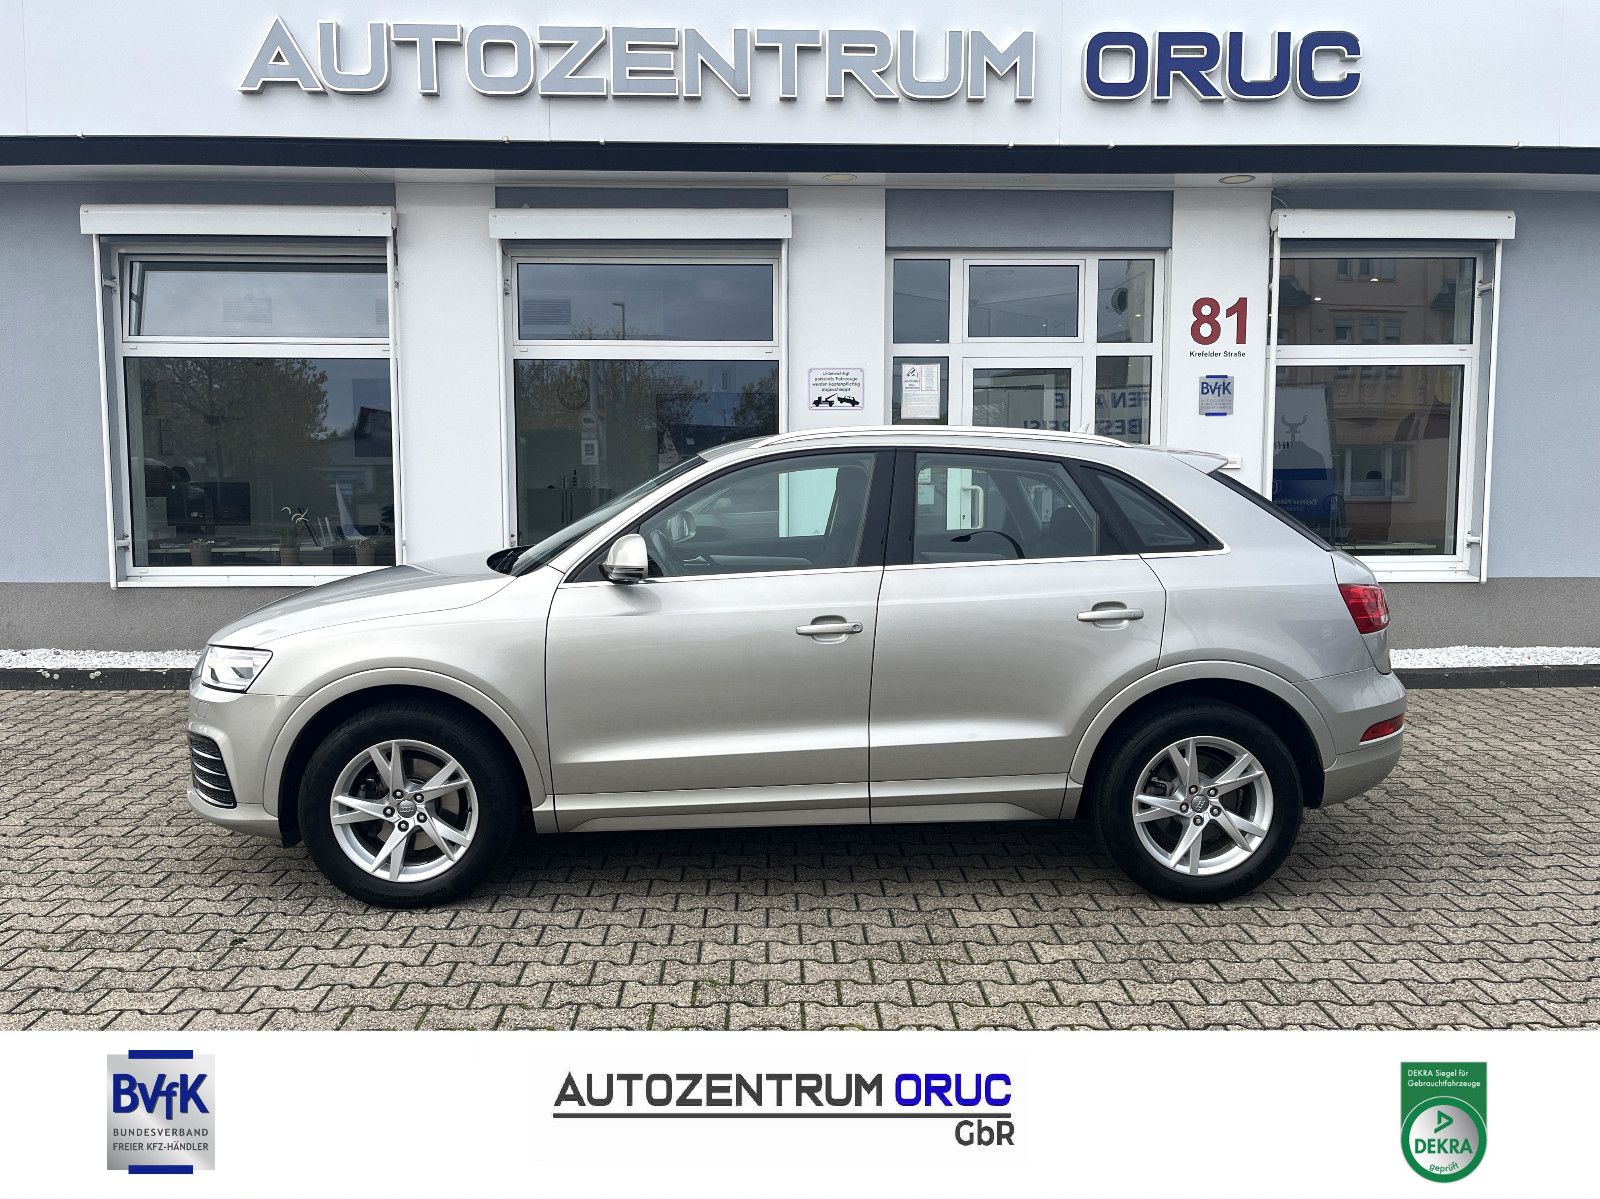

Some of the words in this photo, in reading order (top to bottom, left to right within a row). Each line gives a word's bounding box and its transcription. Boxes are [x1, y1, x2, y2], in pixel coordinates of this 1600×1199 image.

[240, 16, 1036, 102] AUTOZENTRUM
[1083, 30, 1362, 102] ORUC
[1190, 297, 1248, 345] 81
[1223, 350, 1246, 358] Straße
